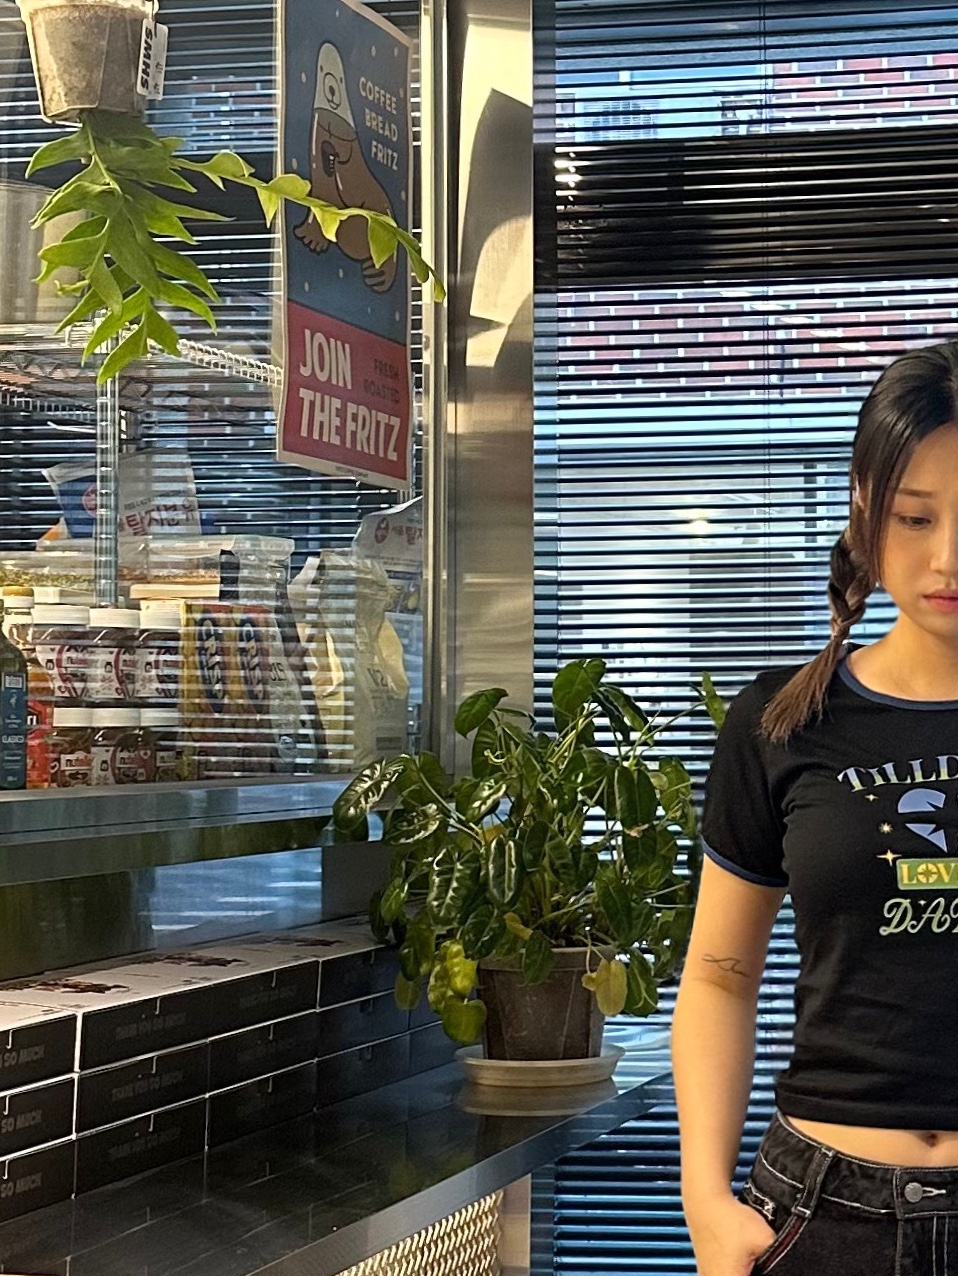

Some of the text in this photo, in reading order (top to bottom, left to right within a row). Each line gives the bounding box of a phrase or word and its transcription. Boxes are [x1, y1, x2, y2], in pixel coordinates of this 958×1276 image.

[359, 76, 397, 115] COFFEE
[364, 108, 398, 142] BREAD
[371, 140, 398, 171] FRITZ
[300, 328, 352, 390] JOIN
[299, 387, 400, 461] THE FRITZ
[3, 1051, 18, 1068] SO
[1, 1117, 15, 1134] SO
